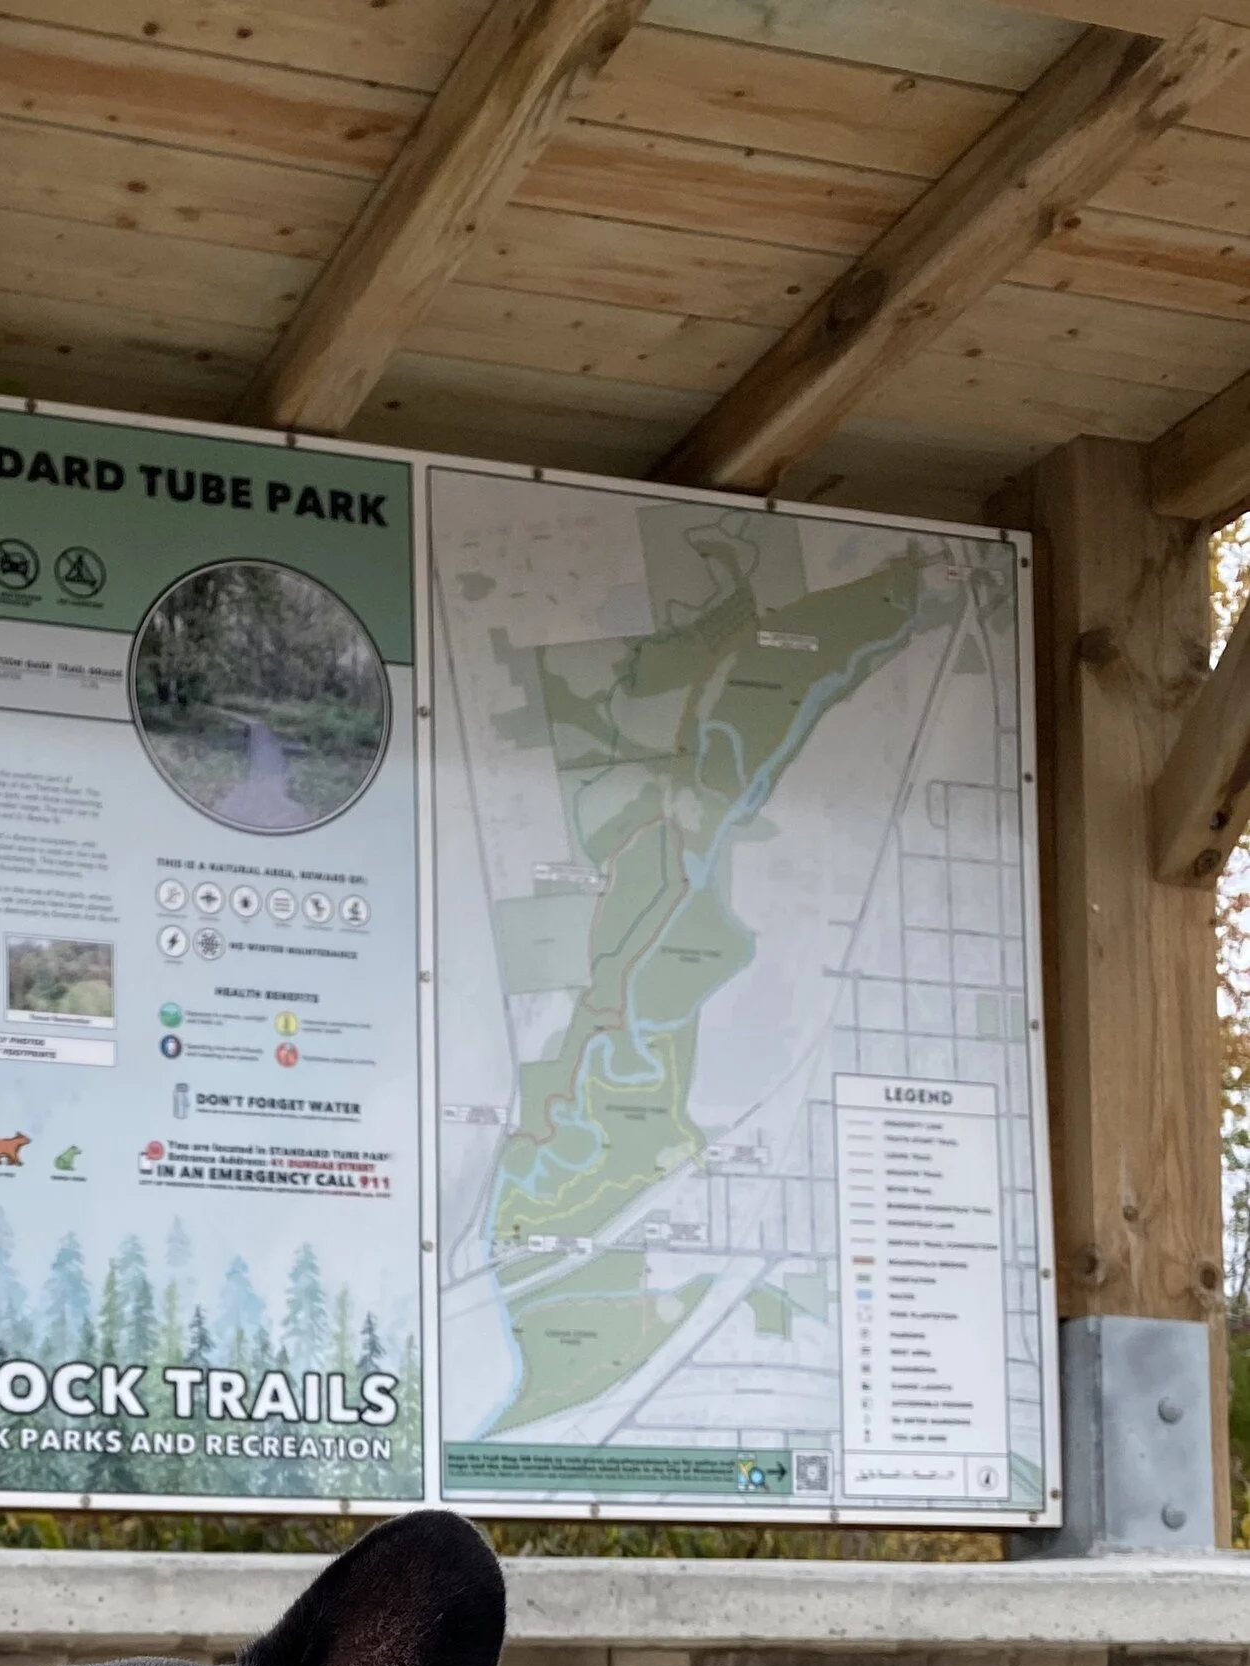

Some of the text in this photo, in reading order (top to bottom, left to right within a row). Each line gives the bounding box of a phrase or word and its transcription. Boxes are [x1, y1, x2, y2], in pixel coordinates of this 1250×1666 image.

[139, 465, 253, 509] TUBE
[267, 481, 388, 527] PARK
[195, 1092, 362, 1115] DON'T FORGET WATER
[884, 1086, 953, 1106] LEGEND
[157, 1165, 175, 1179] IN
[180, 1167, 205, 1181] AN
[208, 1168, 311, 1187] EMERGENCY
[315, 1173, 356, 1189] CALL
[359, 1175, 391, 1191] 911
[165, 1368, 400, 1426] TRAILS
[19, 1428, 121, 1454] PARKS
[131, 1432, 196, 1456] AND
[205, 1434, 392, 1461] RECREATION
